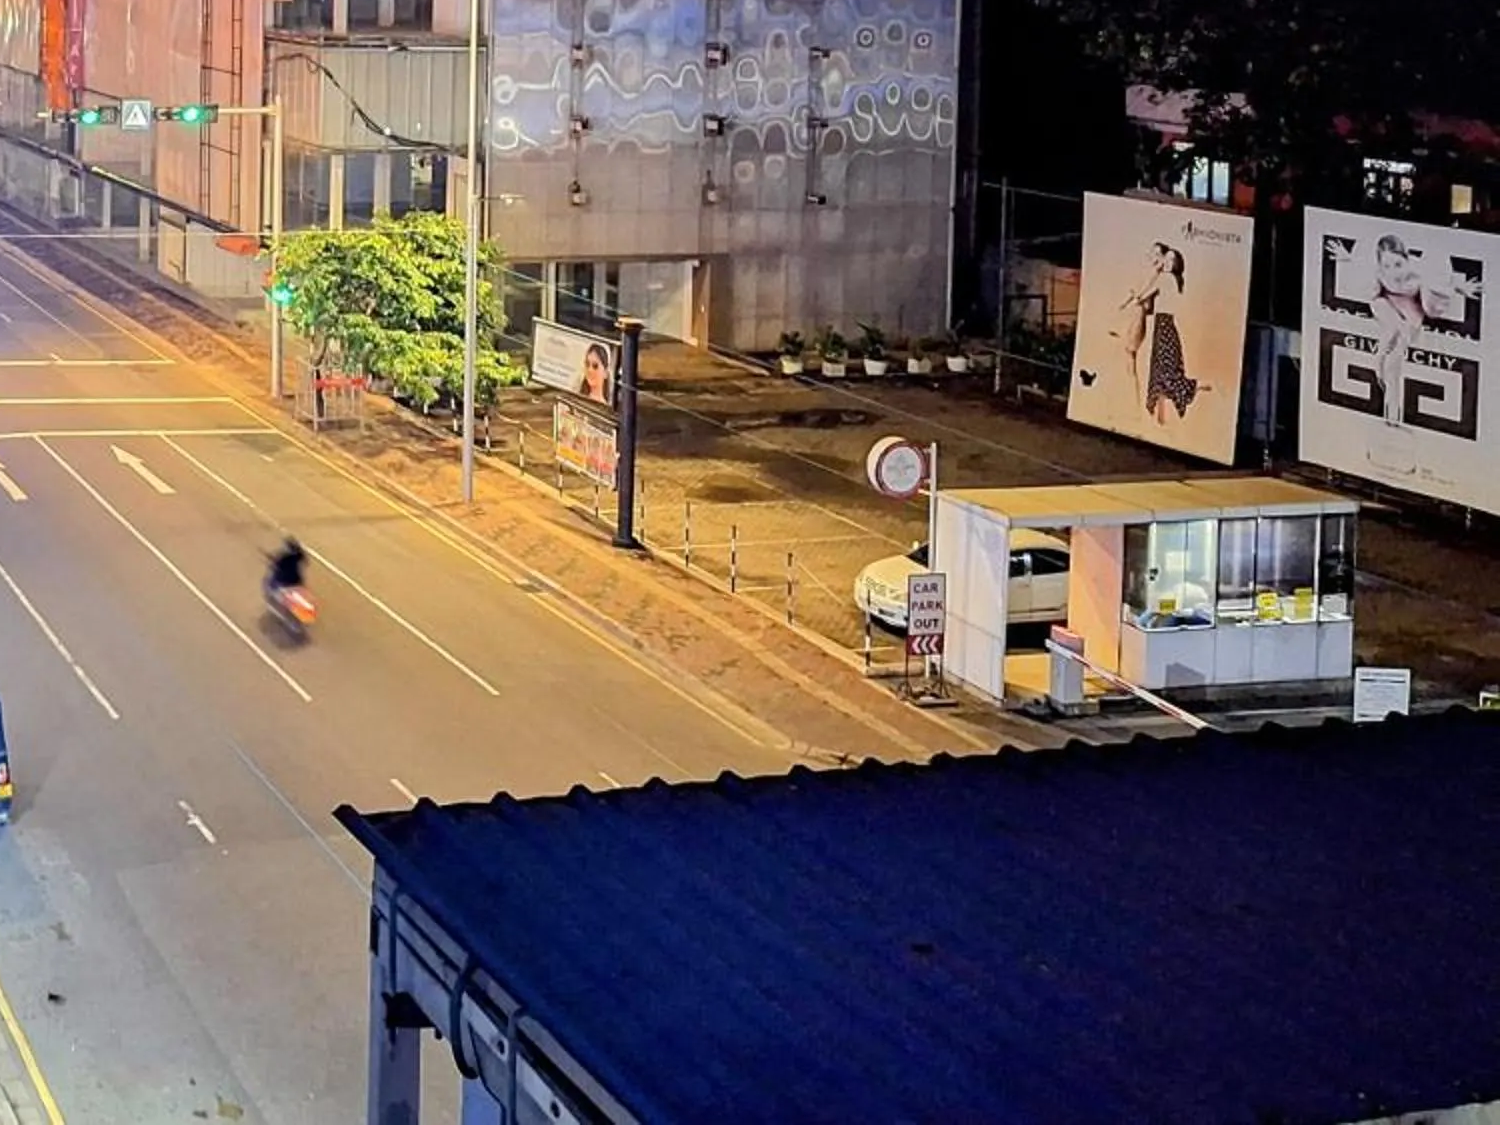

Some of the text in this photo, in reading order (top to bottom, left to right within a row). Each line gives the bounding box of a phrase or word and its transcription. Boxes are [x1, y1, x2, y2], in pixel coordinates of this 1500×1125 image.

[1343, 335, 1458, 371] GIVCHY
[913, 582, 939, 594] CAR
[911, 600, 944, 612] PARK
[913, 618, 939, 629] OUT
